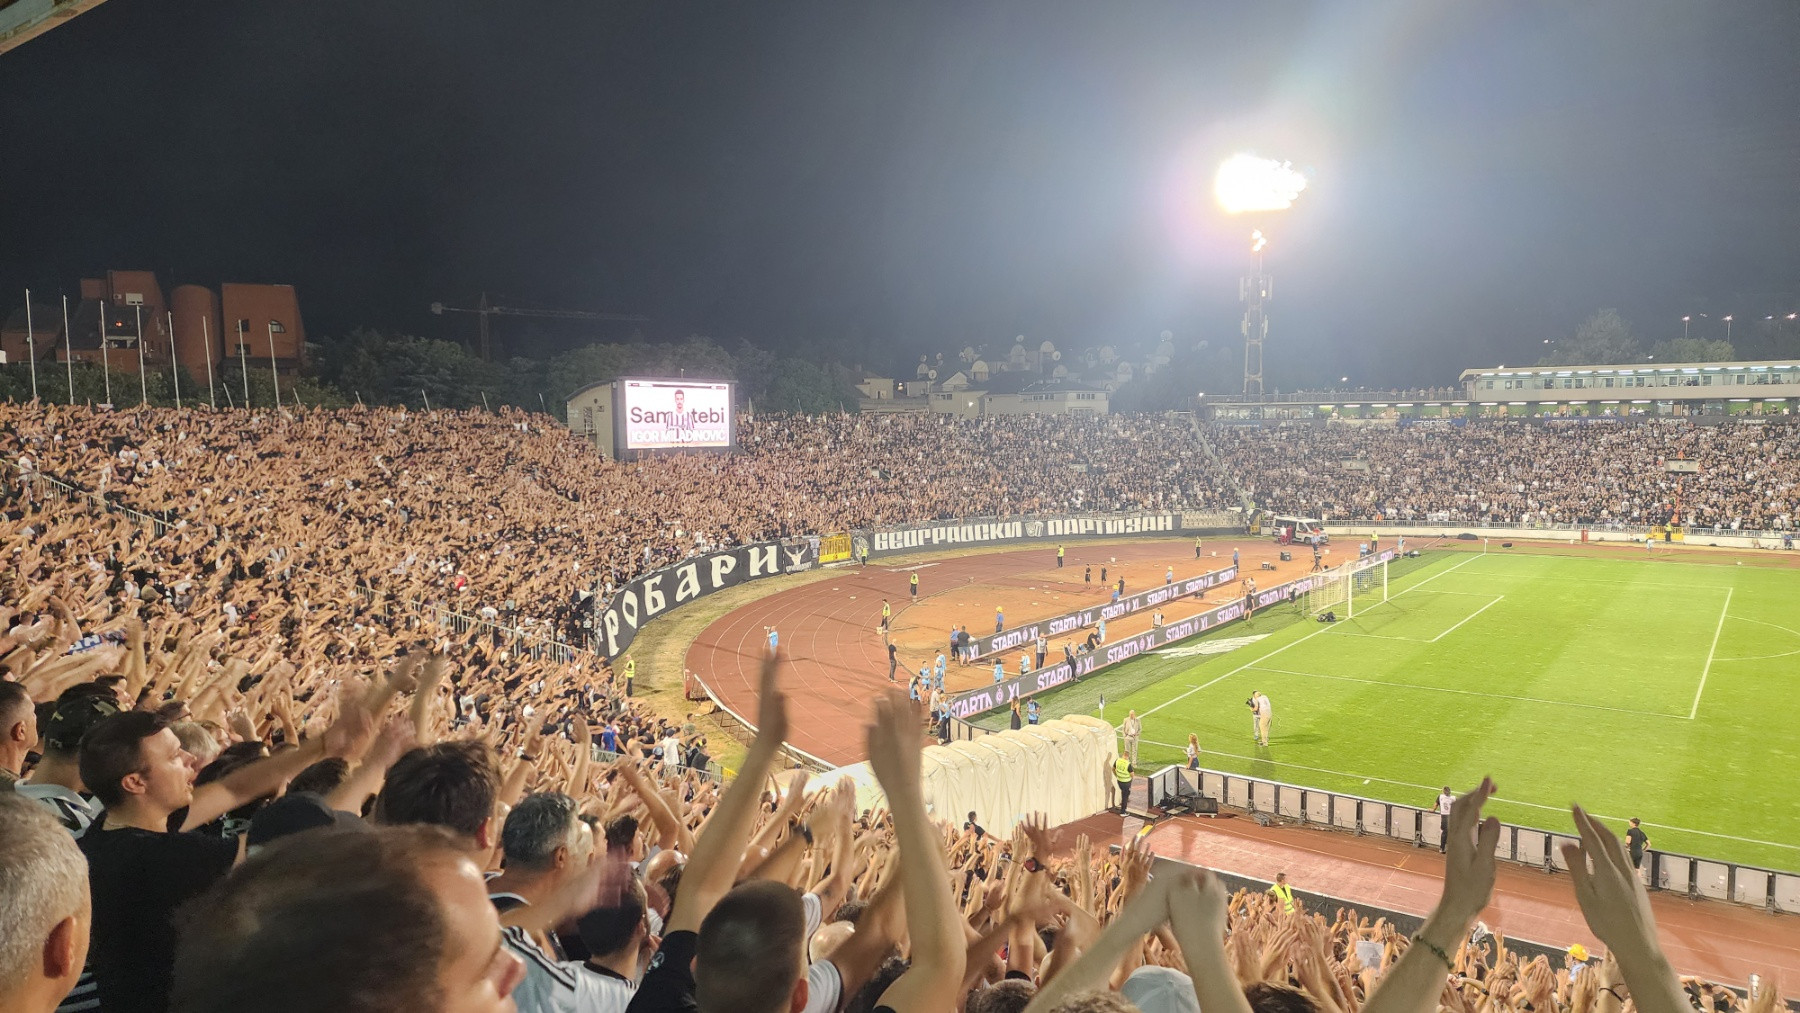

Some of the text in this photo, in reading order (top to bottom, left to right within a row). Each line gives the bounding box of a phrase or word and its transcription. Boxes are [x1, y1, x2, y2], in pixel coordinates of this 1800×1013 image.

[691, 407, 725, 423] tebi
[631, 430, 660, 443] IGOR
[1047, 515, 1173, 536] ПАРТИЗАН
[602, 545, 779, 656] РОБАРИ
[1083, 612, 1092, 626] XI
[1200, 616, 1208, 630] XI
[1030, 626, 1038, 640] XI
[1146, 634, 1155, 650] XI
[1084, 656, 1094, 674] XI
[1007, 682, 1020, 701] XI
